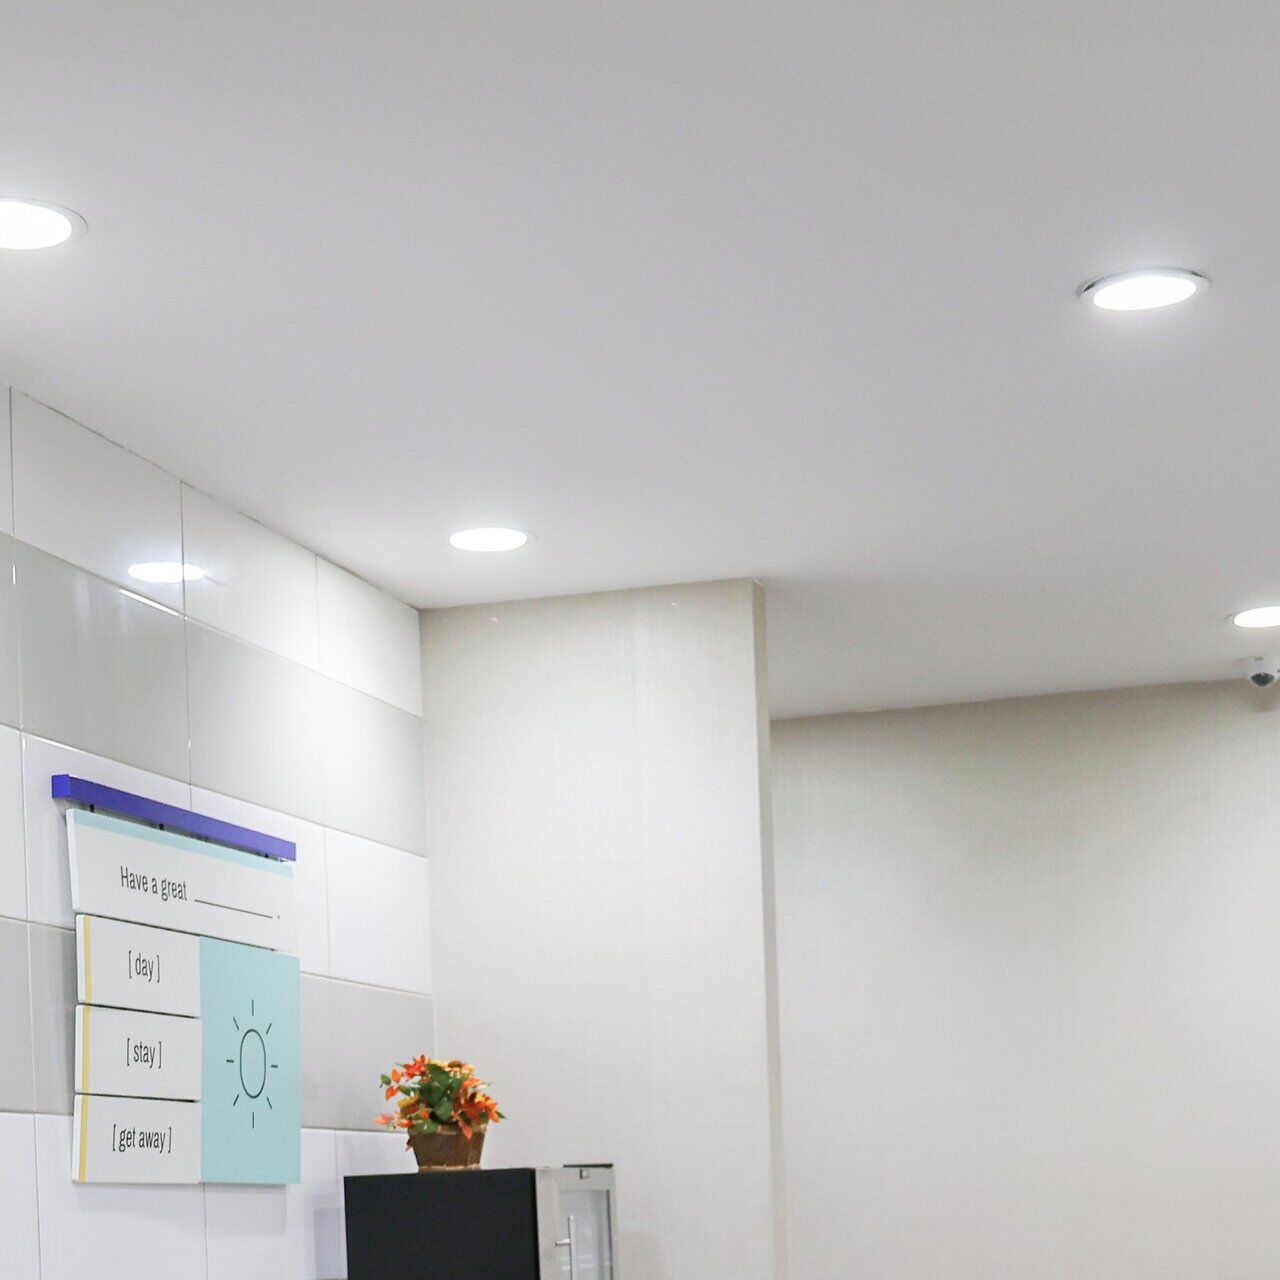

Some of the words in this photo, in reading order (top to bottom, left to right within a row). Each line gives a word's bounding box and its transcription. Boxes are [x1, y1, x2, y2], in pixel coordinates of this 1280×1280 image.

[120, 865, 149, 893] Have
[151, 878, 159, 894] a
[161, 879, 188, 902] great
[135, 955, 155, 982] day
[133, 1040, 156, 1069] stay
[118, 1128, 137, 1153] get
[139, 1131, 166, 1153] away
